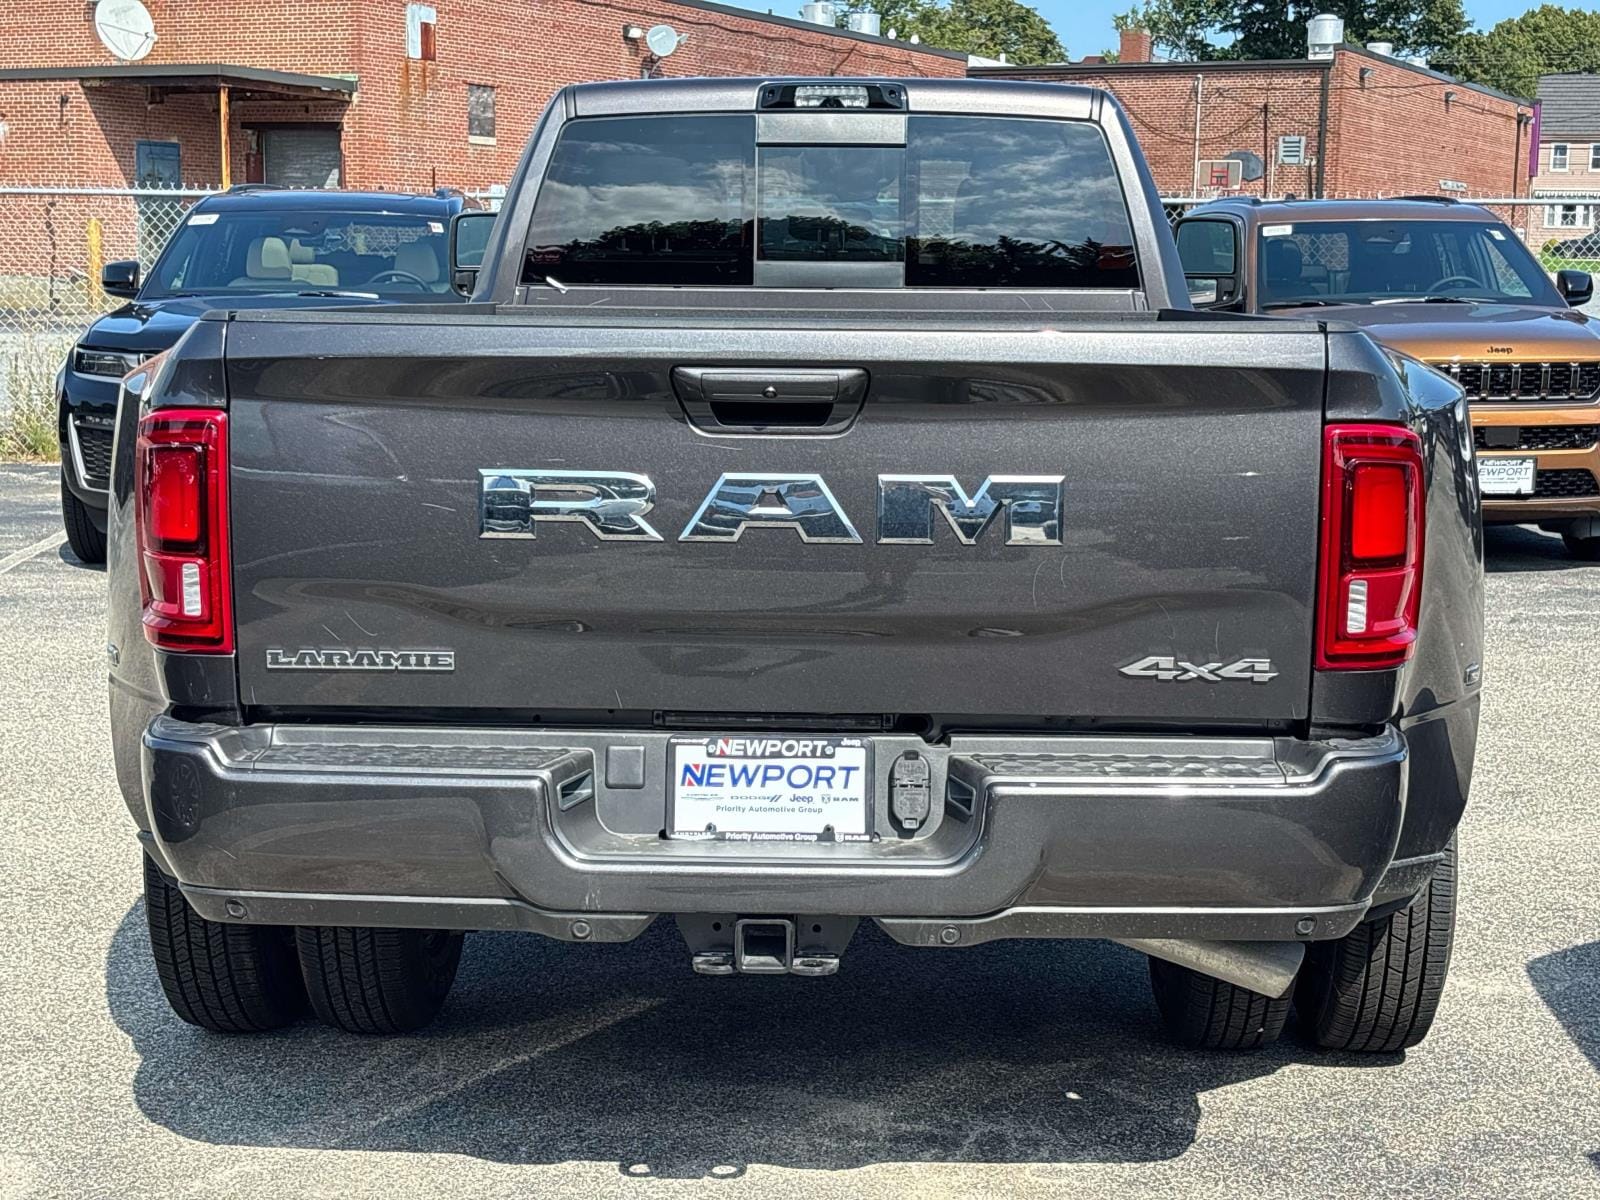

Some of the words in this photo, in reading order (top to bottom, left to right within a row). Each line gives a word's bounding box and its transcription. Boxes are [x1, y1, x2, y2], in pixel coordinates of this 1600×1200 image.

[1487, 346, 1513, 354] Jeep
[1479, 467, 1531, 476] EWPORT
[478, 468, 1066, 546] RAM
[266, 649, 455, 671] LARAMIE
[841, 737, 861, 747] Jeep
[715, 738, 828, 757] NEWPORT
[680, 763, 860, 789] NEWPORT
[789, 793, 814, 804] Jeep
[715, 805, 746, 813] Priority
[798, 806, 823, 814] Group
[725, 832, 752, 842] Priority
[752, 832, 794, 841] Automotive
[794, 833, 818, 842] Group
